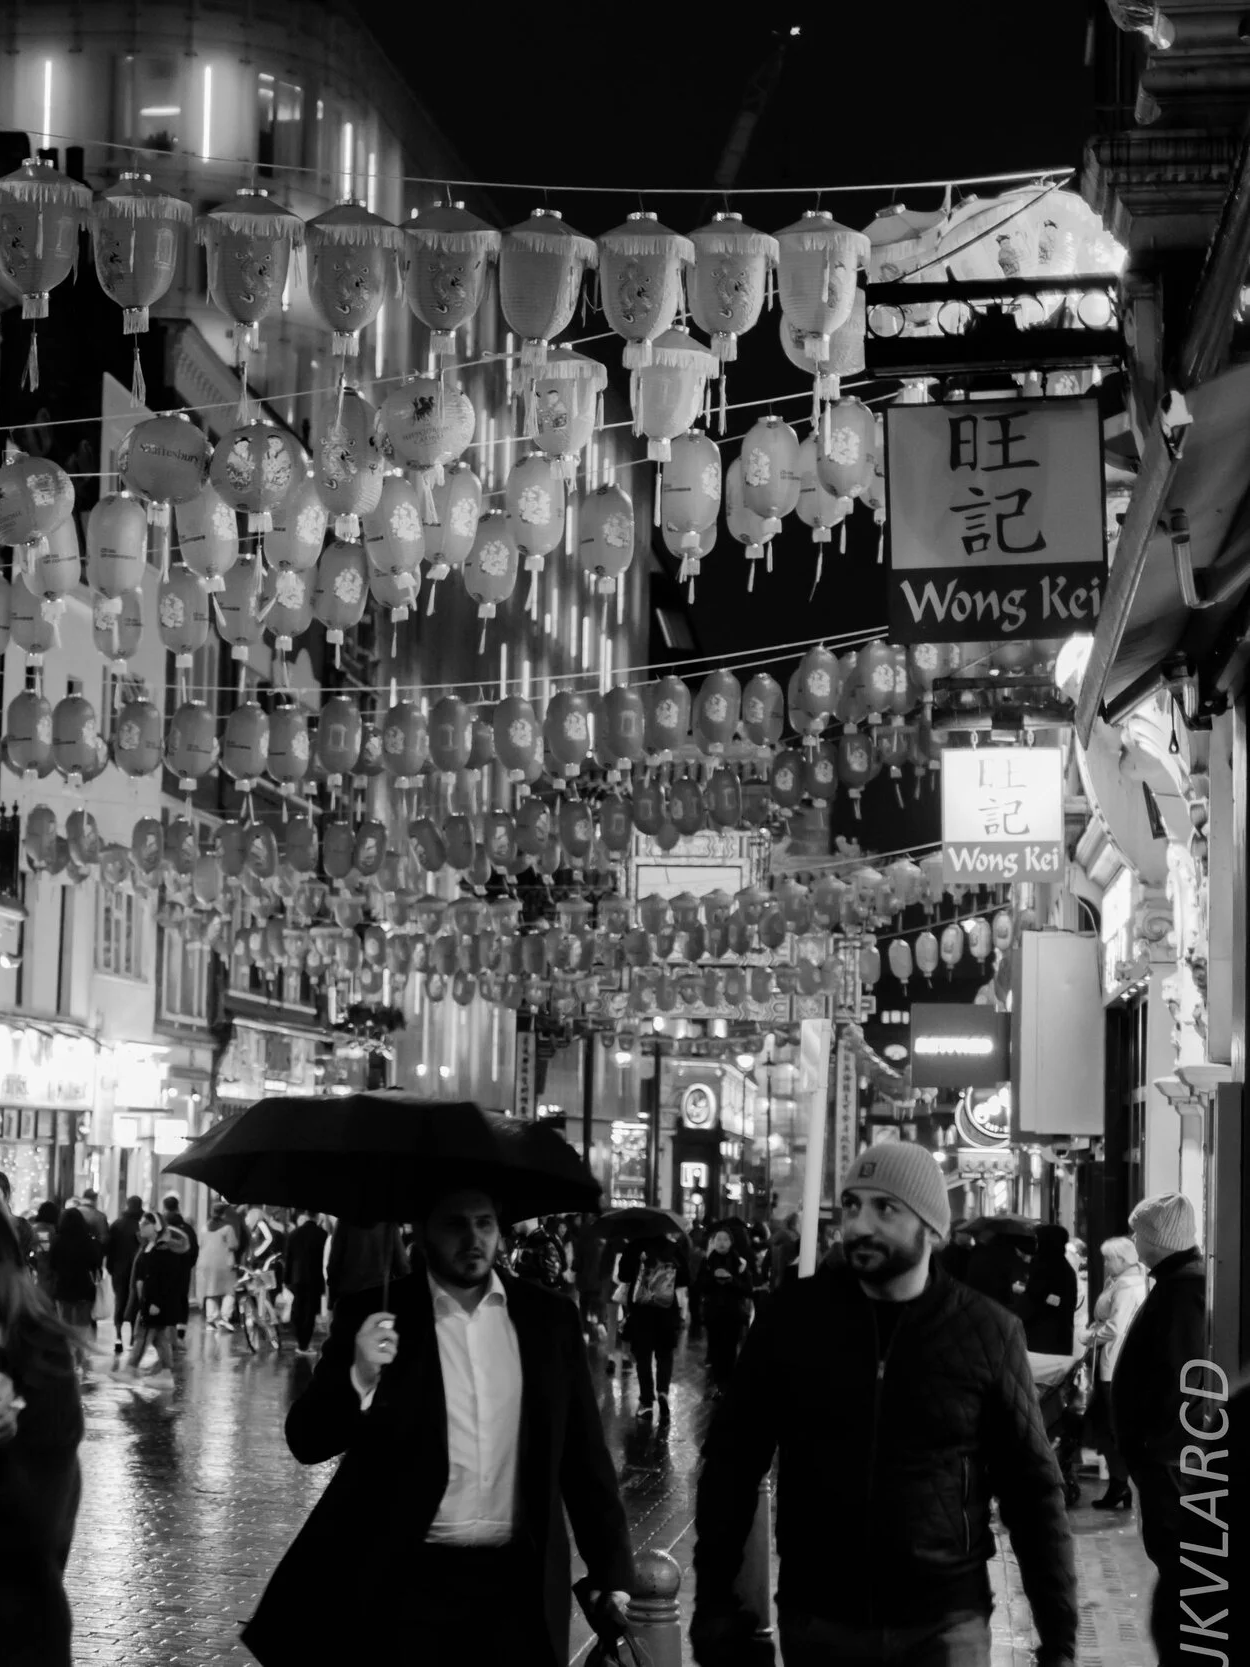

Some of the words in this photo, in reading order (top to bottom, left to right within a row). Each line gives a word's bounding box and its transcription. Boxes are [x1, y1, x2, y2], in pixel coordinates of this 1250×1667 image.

[949, 410, 1047, 556] 旺記
[900, 579, 1027, 633] Wong
[1040, 576, 1100, 620] Kei
[948, 846, 1018, 878] Wong
[1024, 845, 1059, 871] Kei
